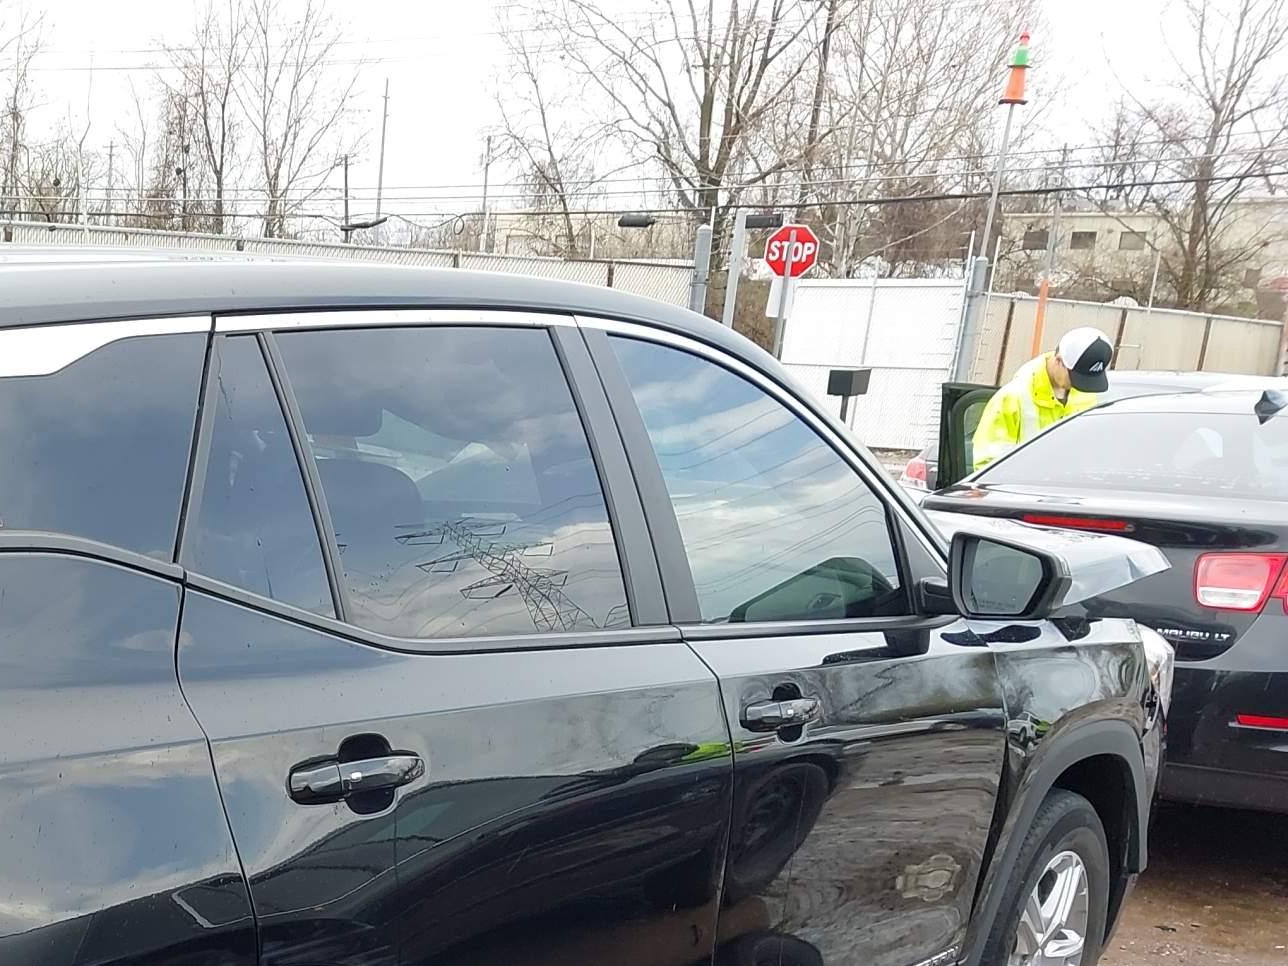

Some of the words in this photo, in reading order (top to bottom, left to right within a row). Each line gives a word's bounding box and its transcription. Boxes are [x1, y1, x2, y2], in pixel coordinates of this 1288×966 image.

[768, 240, 815, 263] STOP
[1156, 628, 1210, 640] MALIBU
[1214, 632, 1231, 641] LT
